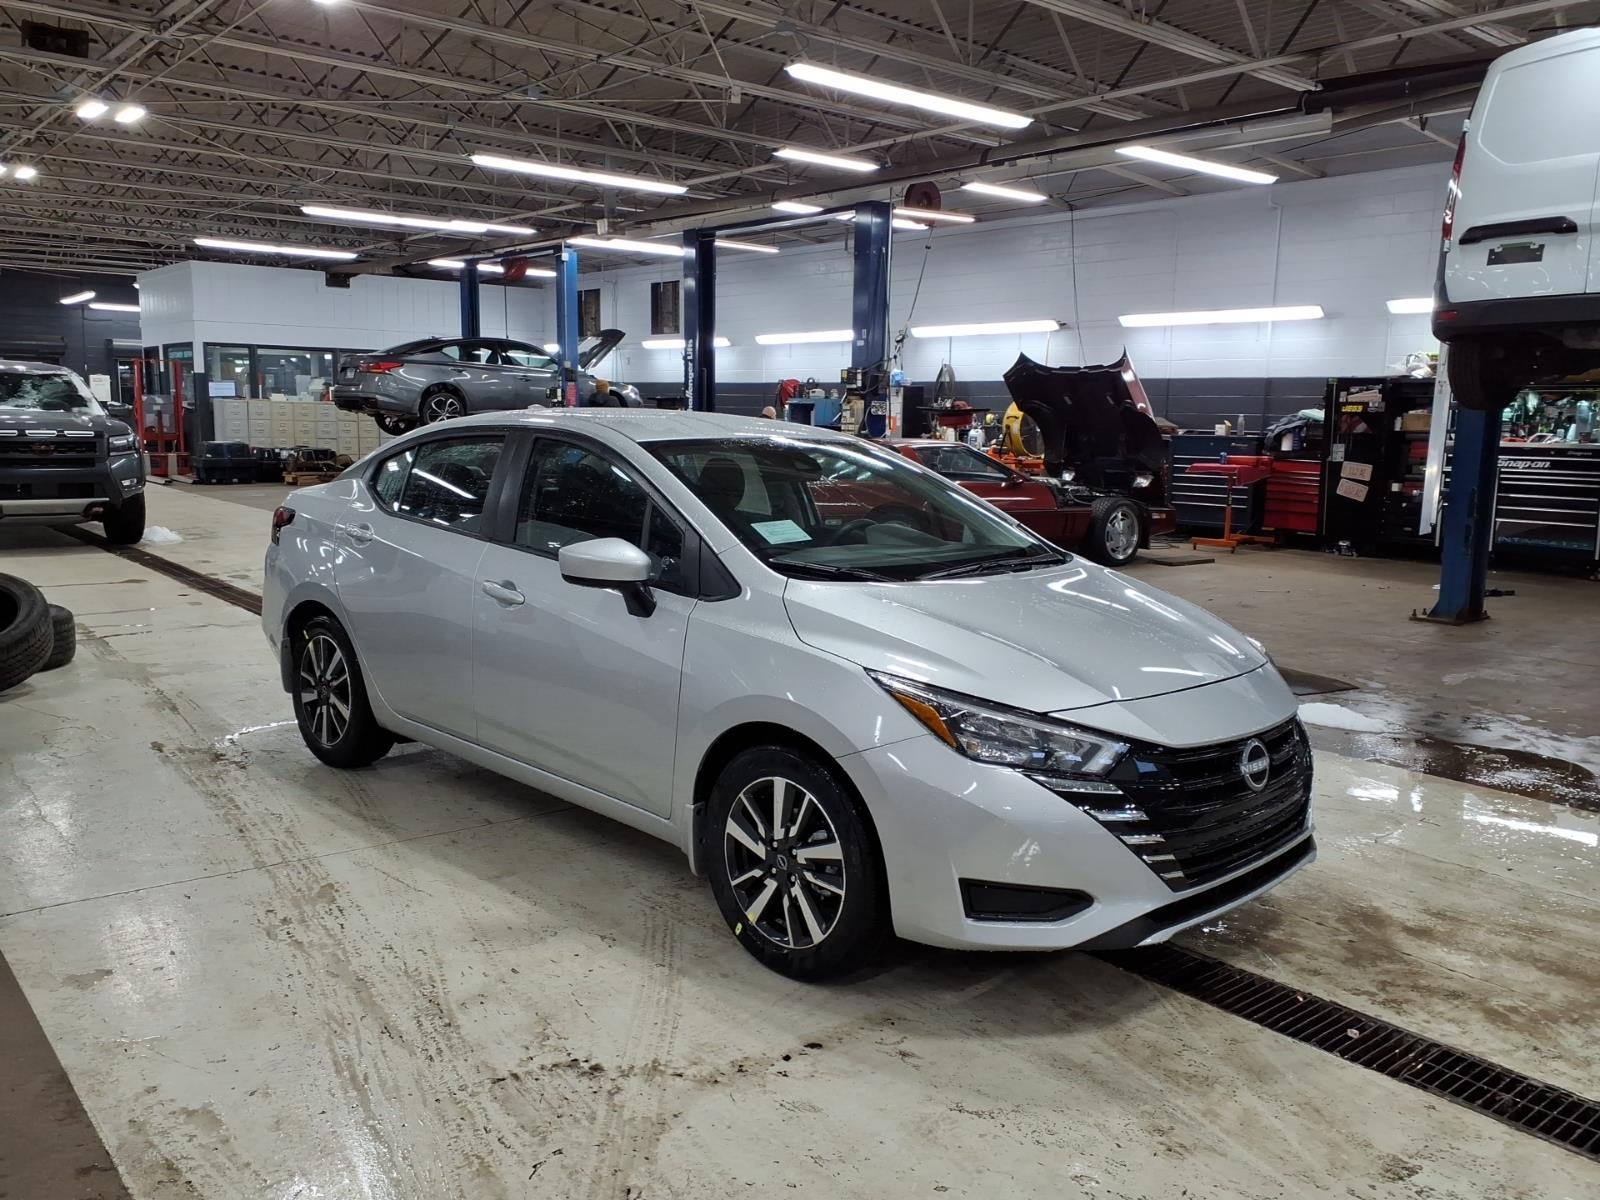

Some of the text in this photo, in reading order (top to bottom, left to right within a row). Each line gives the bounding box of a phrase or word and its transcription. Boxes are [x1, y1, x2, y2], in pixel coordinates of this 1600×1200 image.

[686, 338, 694, 360] Lifts
[1497, 458, 1551, 469] Snap-on
[1240, 758, 1269, 775] NISSA
